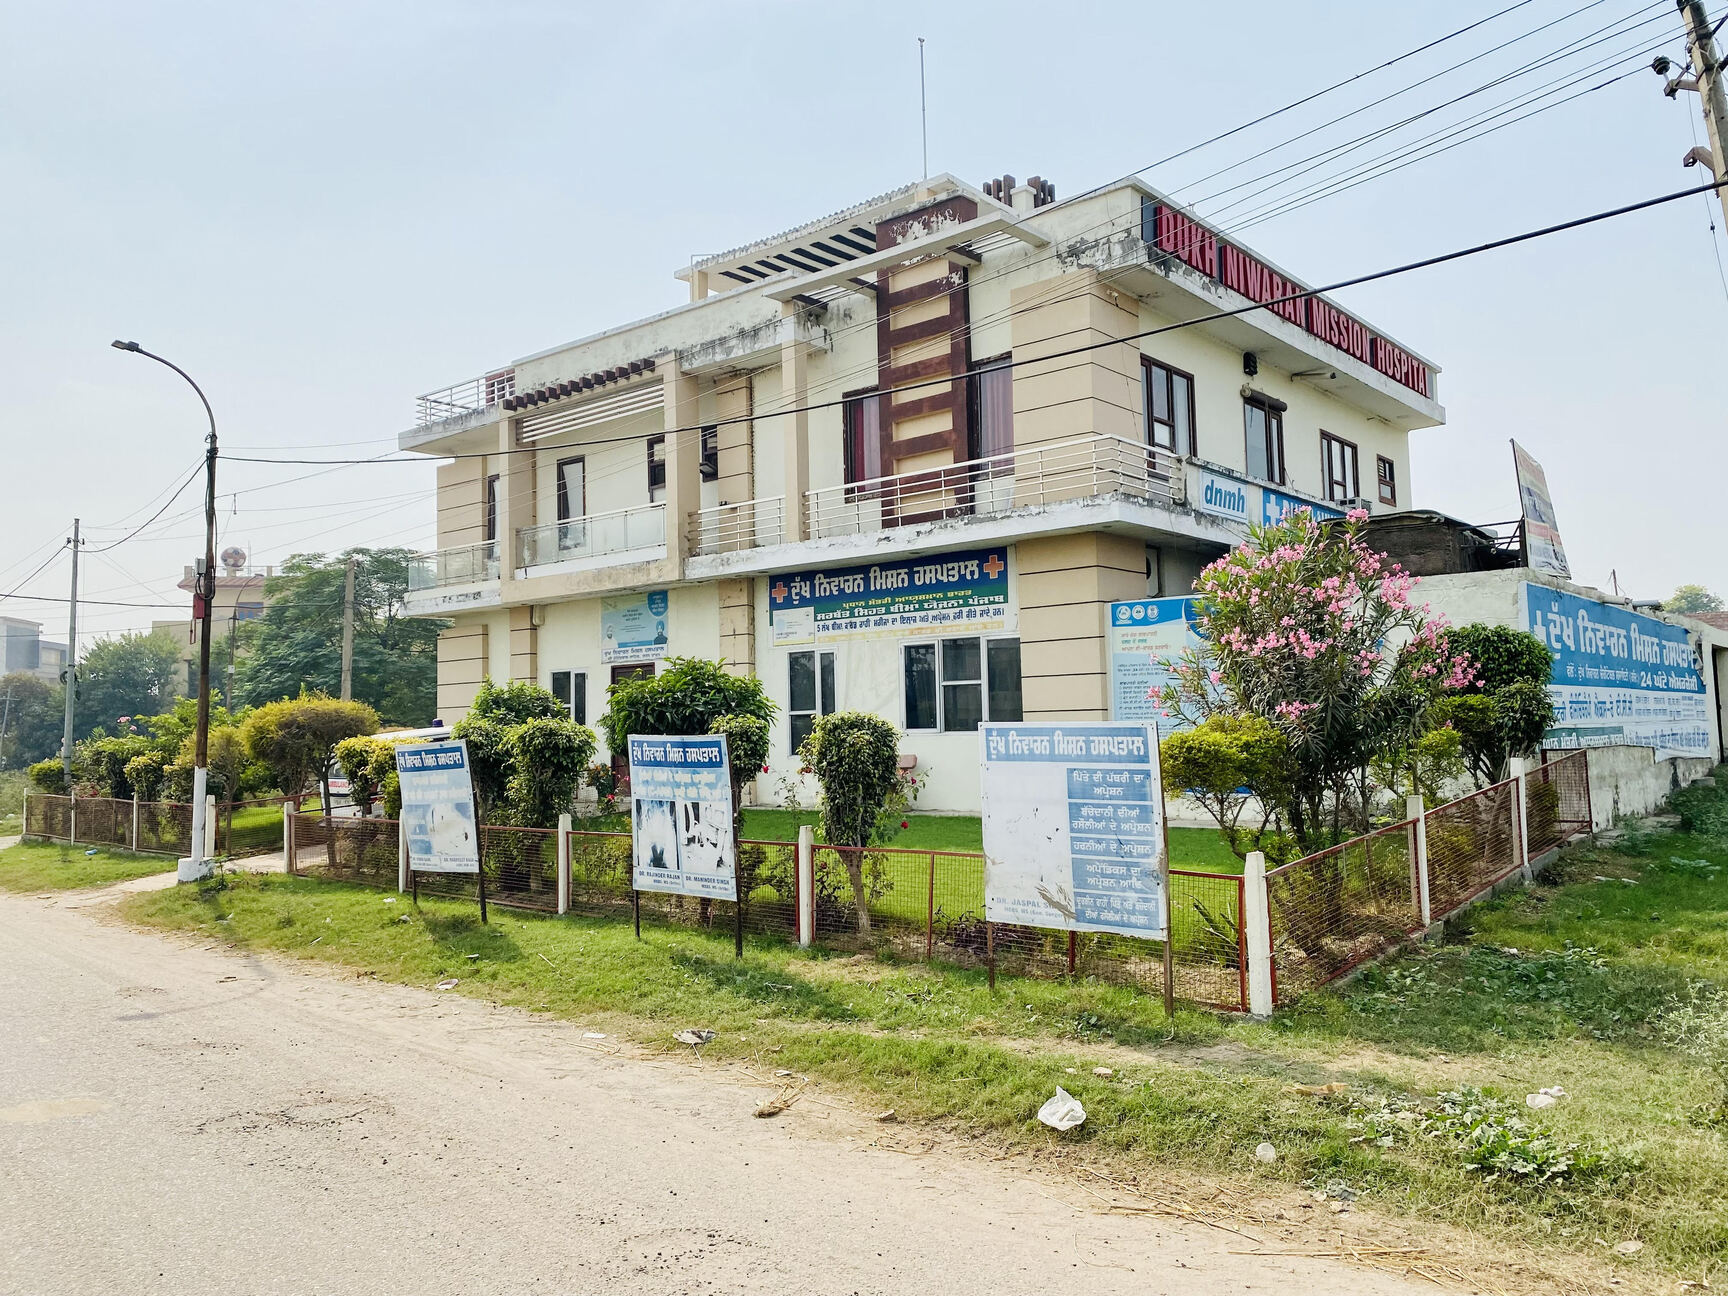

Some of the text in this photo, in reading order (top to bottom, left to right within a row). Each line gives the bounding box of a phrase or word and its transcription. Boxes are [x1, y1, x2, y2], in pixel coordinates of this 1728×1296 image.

[1158, 205, 1432, 398] DUKH NIWARAN MISSION HOSPITAL
[1204, 479, 1245, 513] dnmh
[790, 559, 980, 604] ਦੁੱਖ ਨਿਵਾਰਨ ਮਿਸ਼ਨ ਹਸਪਤਾਲ
[854, 606, 885, 618] ਸਿਹਤ
[890, 603, 919, 613] ਬੀਮਾ
[968, 595, 1004, 605] ਪੰਜਾਬ
[1547, 601, 1575, 660] ਦੁੱਖ
[1577, 609, 1628, 659] ਨਿਵਾਰਨ
[1640, 671, 1652, 688] 24
[643, 743, 664, 762] ਨਿਵਾਰਨ
[685, 747, 720, 762] ਹਸਪਤਾਲ
[1008, 730, 1050, 755] ਨਿਵਾਰਨ
[1053, 730, 1087, 757] ਮਿਸ਼ਨ
[1089, 736, 1145, 756] ਹਸਪਤਾਲ
[1093, 771, 1103, 782] ਦੀ
[1133, 774, 1144, 783] ਦਾ
[1117, 806, 1140, 817] ਦੀਆਂ
[1109, 819, 1117, 831] ਦੇ
[1011, 898, 1040, 908] JASPAL
